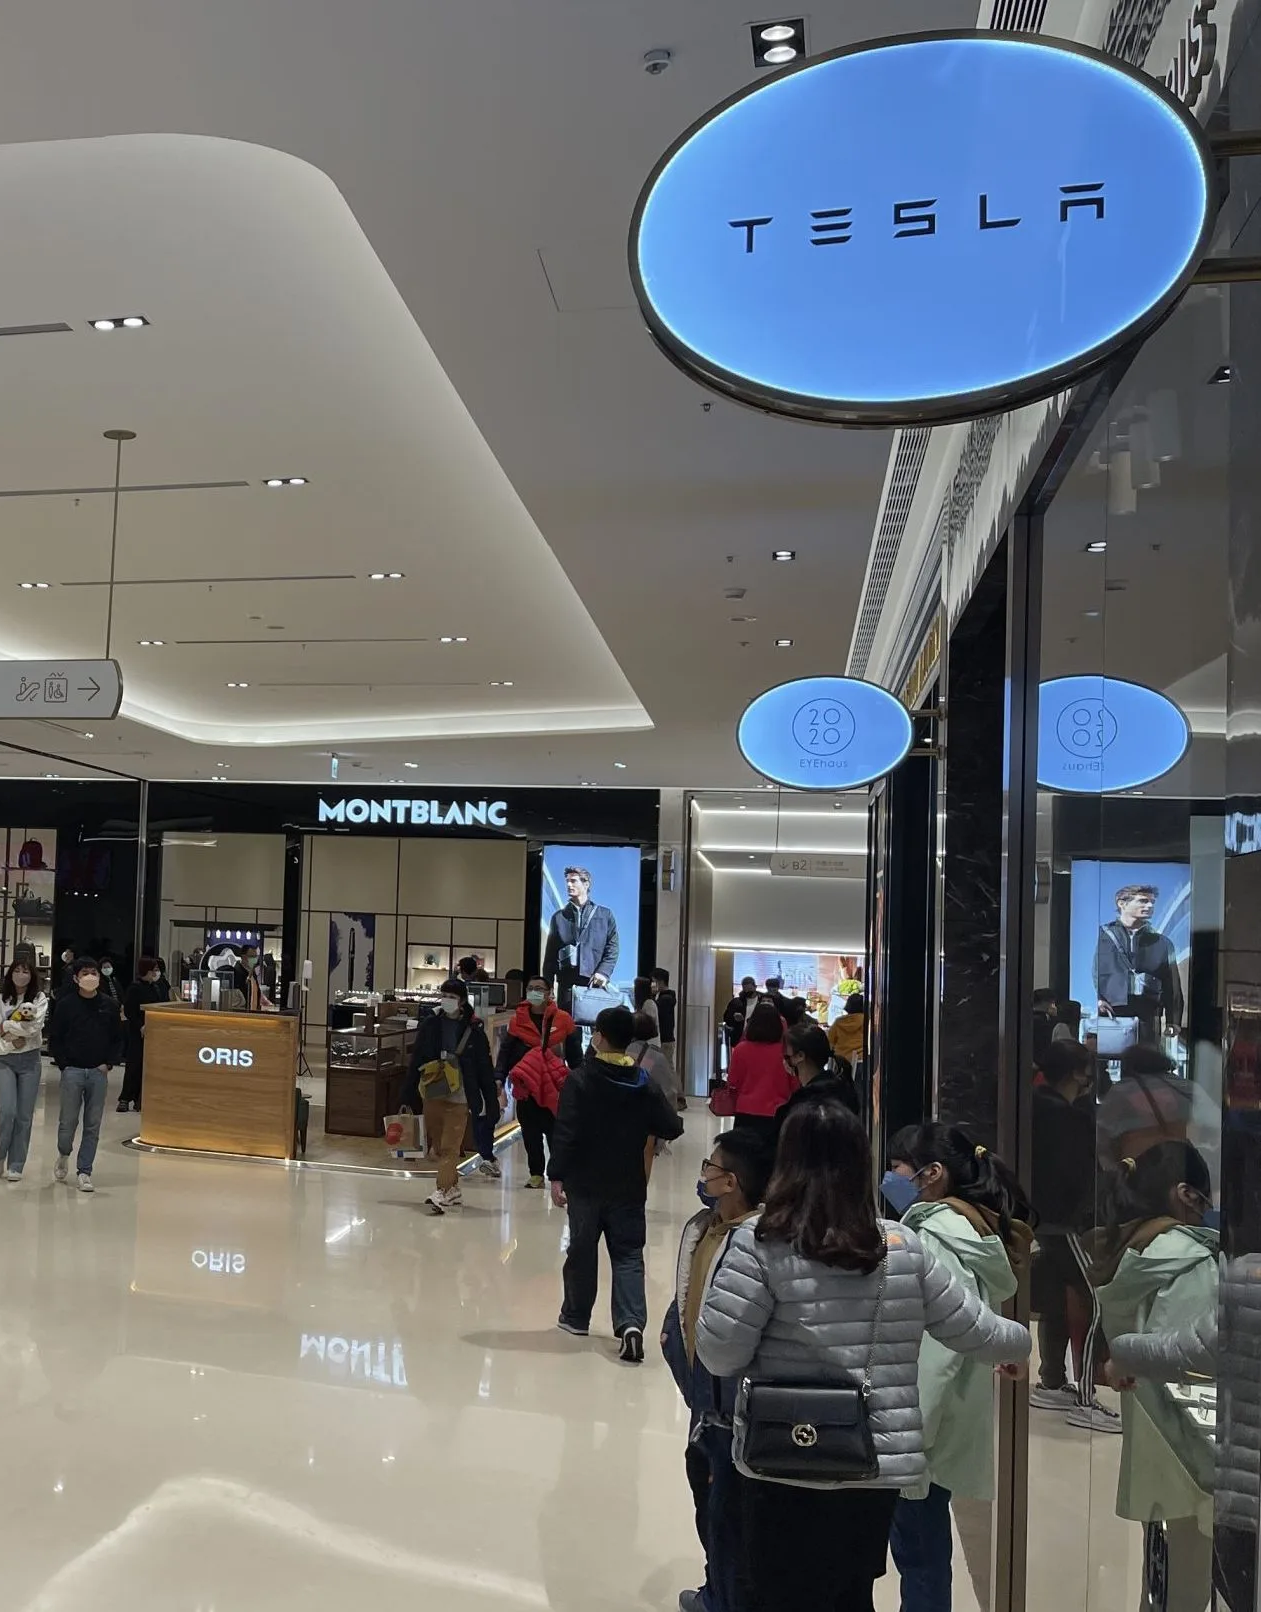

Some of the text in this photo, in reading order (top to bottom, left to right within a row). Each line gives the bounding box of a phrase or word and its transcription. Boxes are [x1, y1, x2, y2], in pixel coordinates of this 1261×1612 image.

[728, 182, 1106, 253] TESLA
[808, 708, 840, 726] 20
[808, 728, 840, 745] 20
[318, 798, 507, 826] MONTBLANC
[792, 860, 807, 871] B2
[198, 1046, 253, 1067] ORIS
